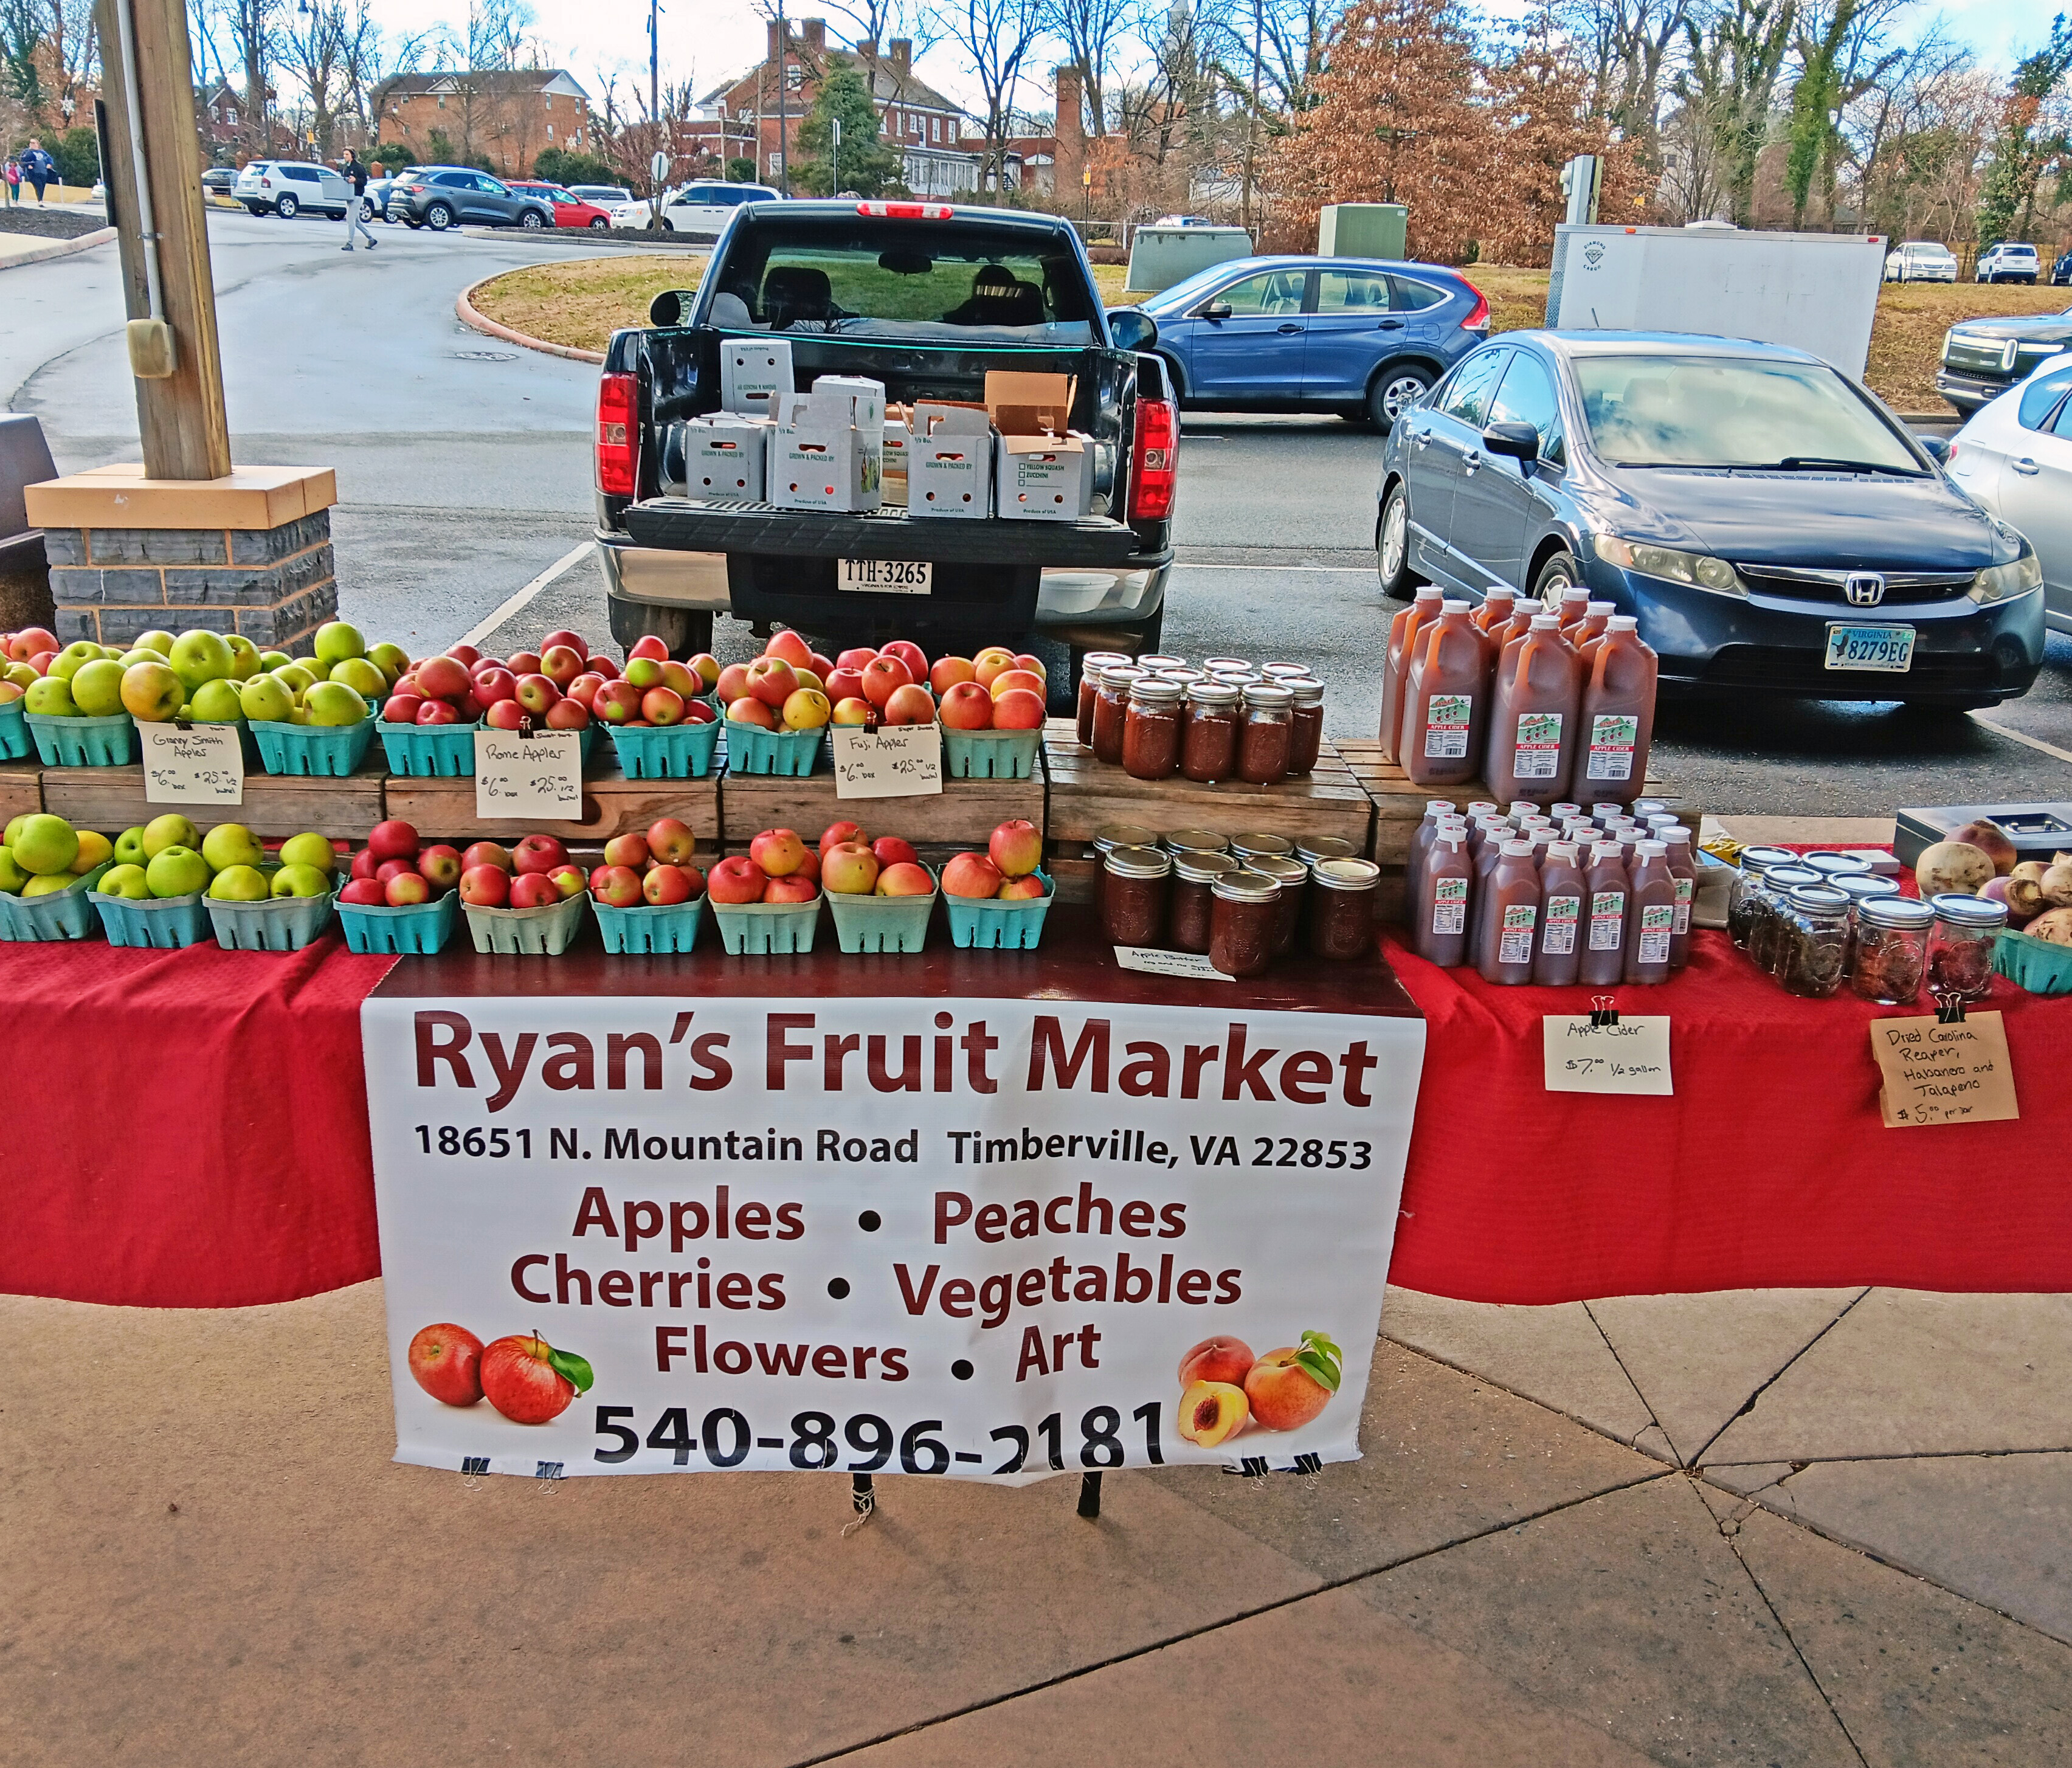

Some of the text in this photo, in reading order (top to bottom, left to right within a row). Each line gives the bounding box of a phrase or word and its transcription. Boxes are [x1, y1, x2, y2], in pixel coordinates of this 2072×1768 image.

[1584, 241, 1606, 249] DIAMOND
[845, 559, 927, 584] TTH-3265
[1852, 630, 1893, 640] VIRGINIA
[1848, 640, 1909, 663] 8279EG
[153, 734, 223, 749] Granny Smith
[849, 736, 909, 751] Fuji Apples
[174, 746, 207, 759] Apples
[486, 744, 566, 762] Rome Apples
[1567, 1023, 1645, 1037] Apple Cider
[1886, 1028, 1978, 1046] Dried Carolina
[767, 1011, 998, 1094] Fruit
[1026, 1015, 1378, 1108] Market
[1899, 1046, 1960, 1062] Reaper,
[1611, 1063, 1625, 1076] 1/2
[1629, 1065, 1661, 1076] gallon
[1904, 1059, 1994, 1082] Habanero and
[415, 1124, 1372, 1170] 18651 N. Mountain Road Timberville, VA 22853
[572, 1181, 1187, 1252] Apples Peaches
[511, 1252, 1243, 1328] Cherries Vegetables
[656, 1324, 1102, 1383] Flowers Art
[593, 1401, 1166, 1476] 540-896-2181
